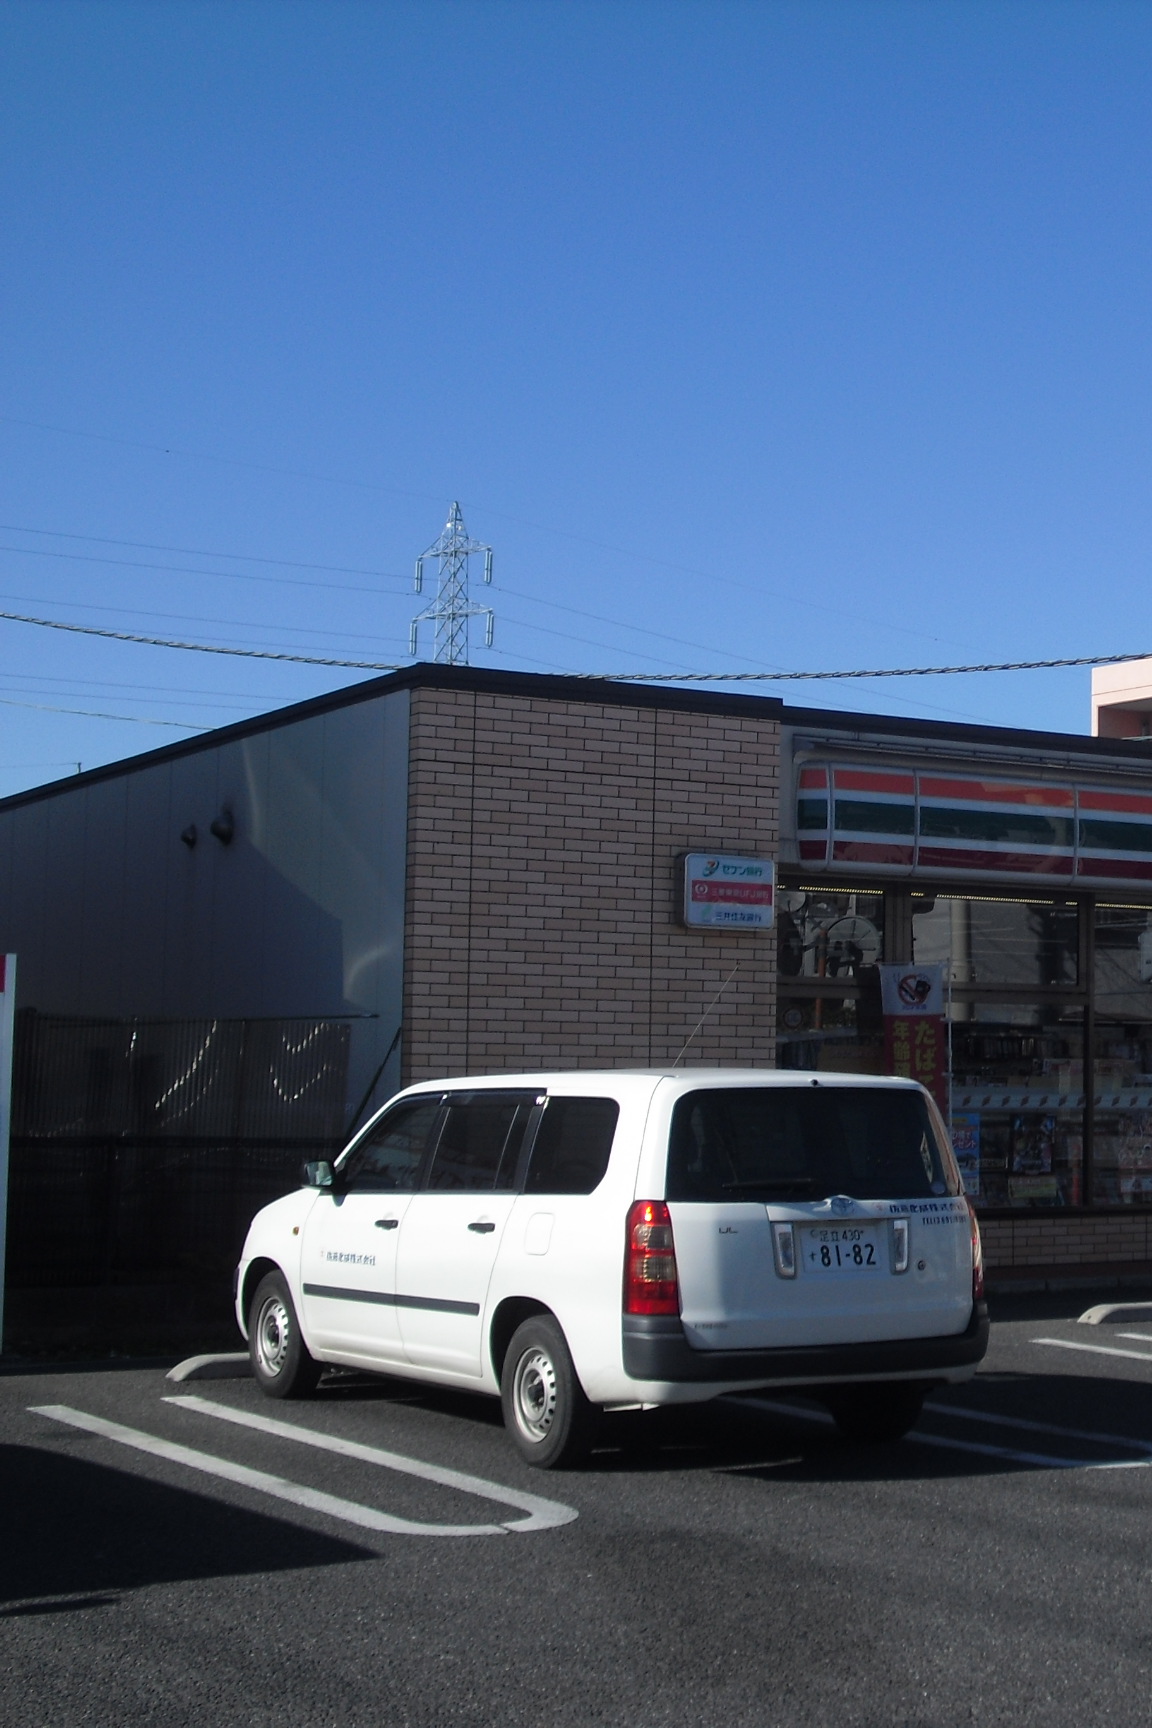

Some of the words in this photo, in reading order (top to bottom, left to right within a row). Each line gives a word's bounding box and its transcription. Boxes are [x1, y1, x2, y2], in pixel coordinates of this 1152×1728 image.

[722, 865, 763, 877] セブン銀行
[715, 911, 762, 922] 三井住友銀行
[820, 1243, 877, 1267] 81-82
